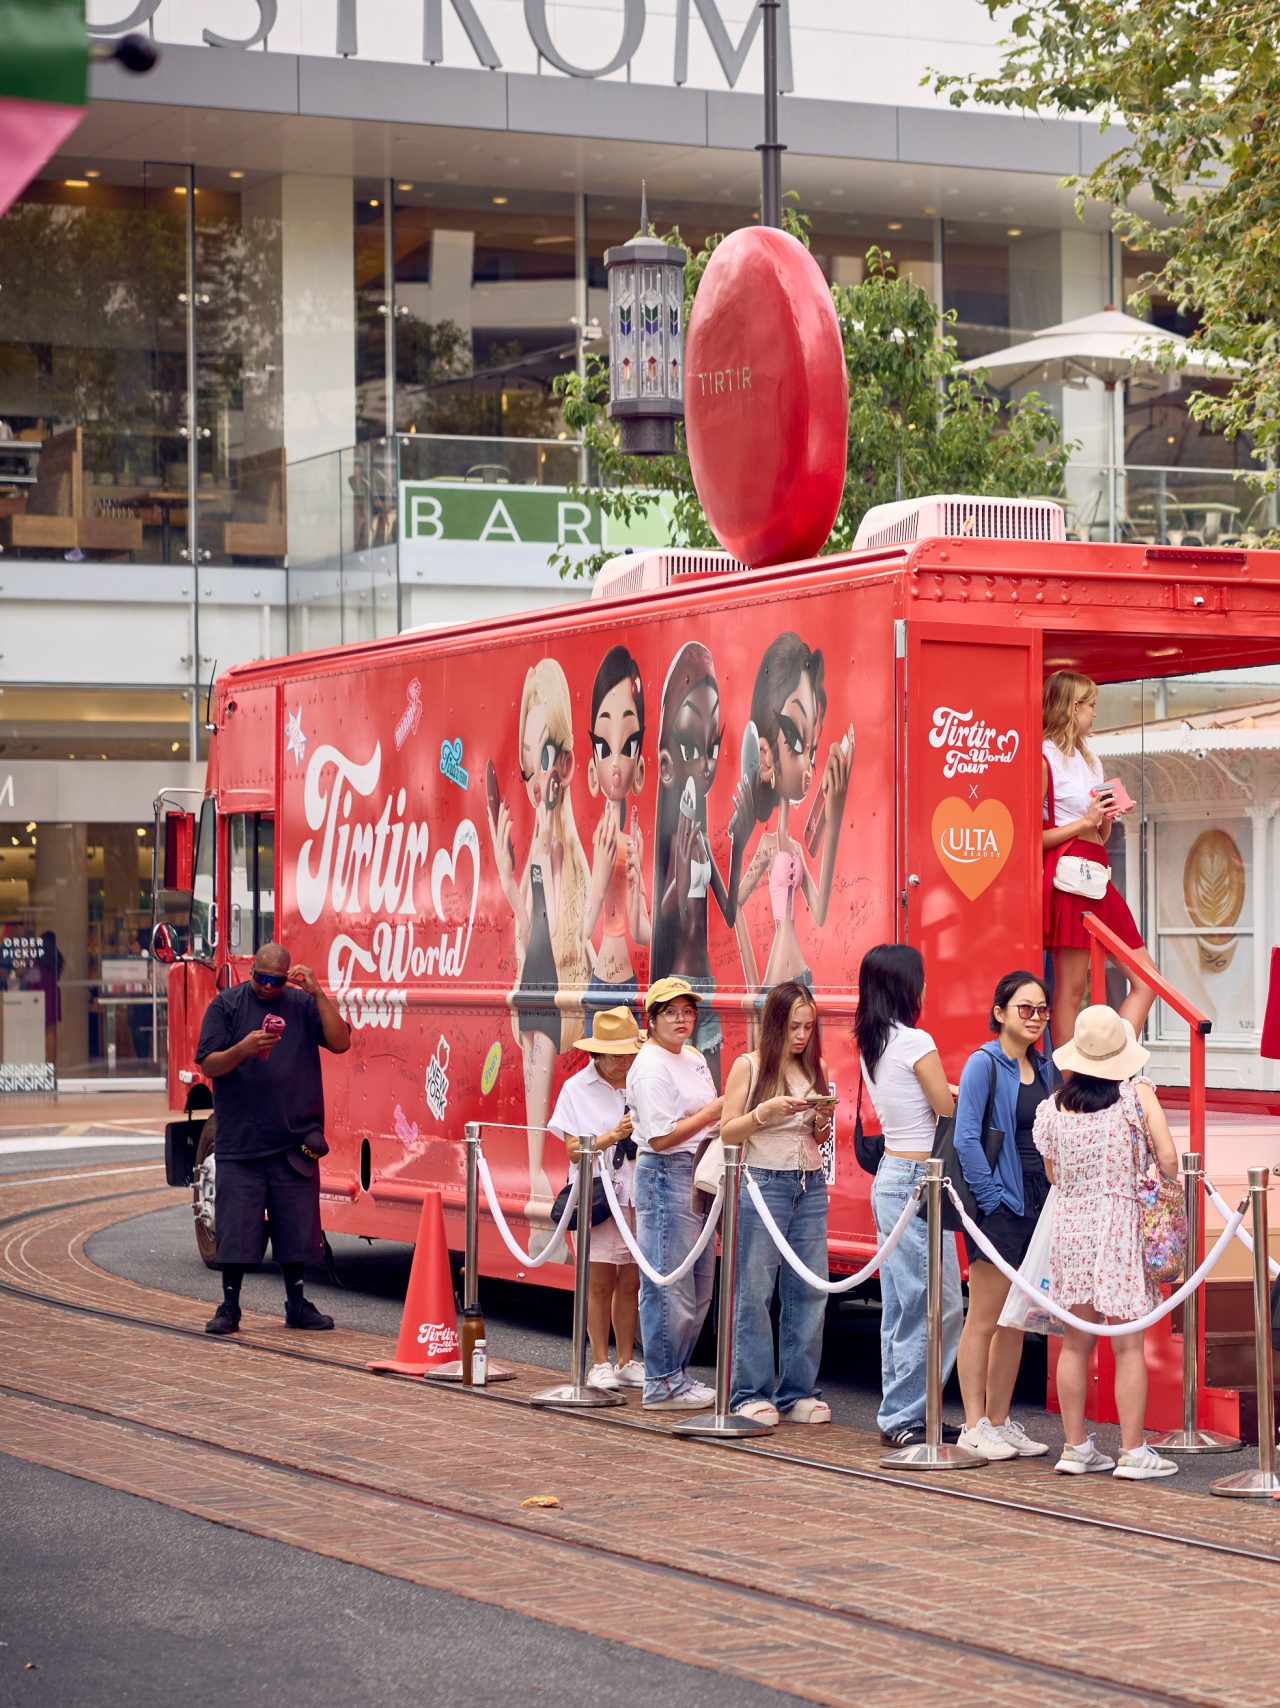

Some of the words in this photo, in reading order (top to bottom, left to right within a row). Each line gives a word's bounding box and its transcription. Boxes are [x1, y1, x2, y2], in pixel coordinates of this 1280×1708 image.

[697, 366, 752, 396] TIRTIR
[411, 495, 592, 545] BAR
[928, 706, 997, 748] Tirtir
[943, 750, 988, 779] Tour
[969, 749, 1013, 763] World
[296, 739, 430, 925] Tirtir
[949, 827, 998, 852] ULTA
[963, 850, 1001, 859] BEAUTY
[2, 948, 45, 959] PICKUP
[3, 937, 44, 948] ORDER
[373, 921, 465, 984] World
[328, 933, 408, 1030] Tour
[417, 1322, 455, 1344] Tirtir
[427, 1342, 453, 1357] Tour
